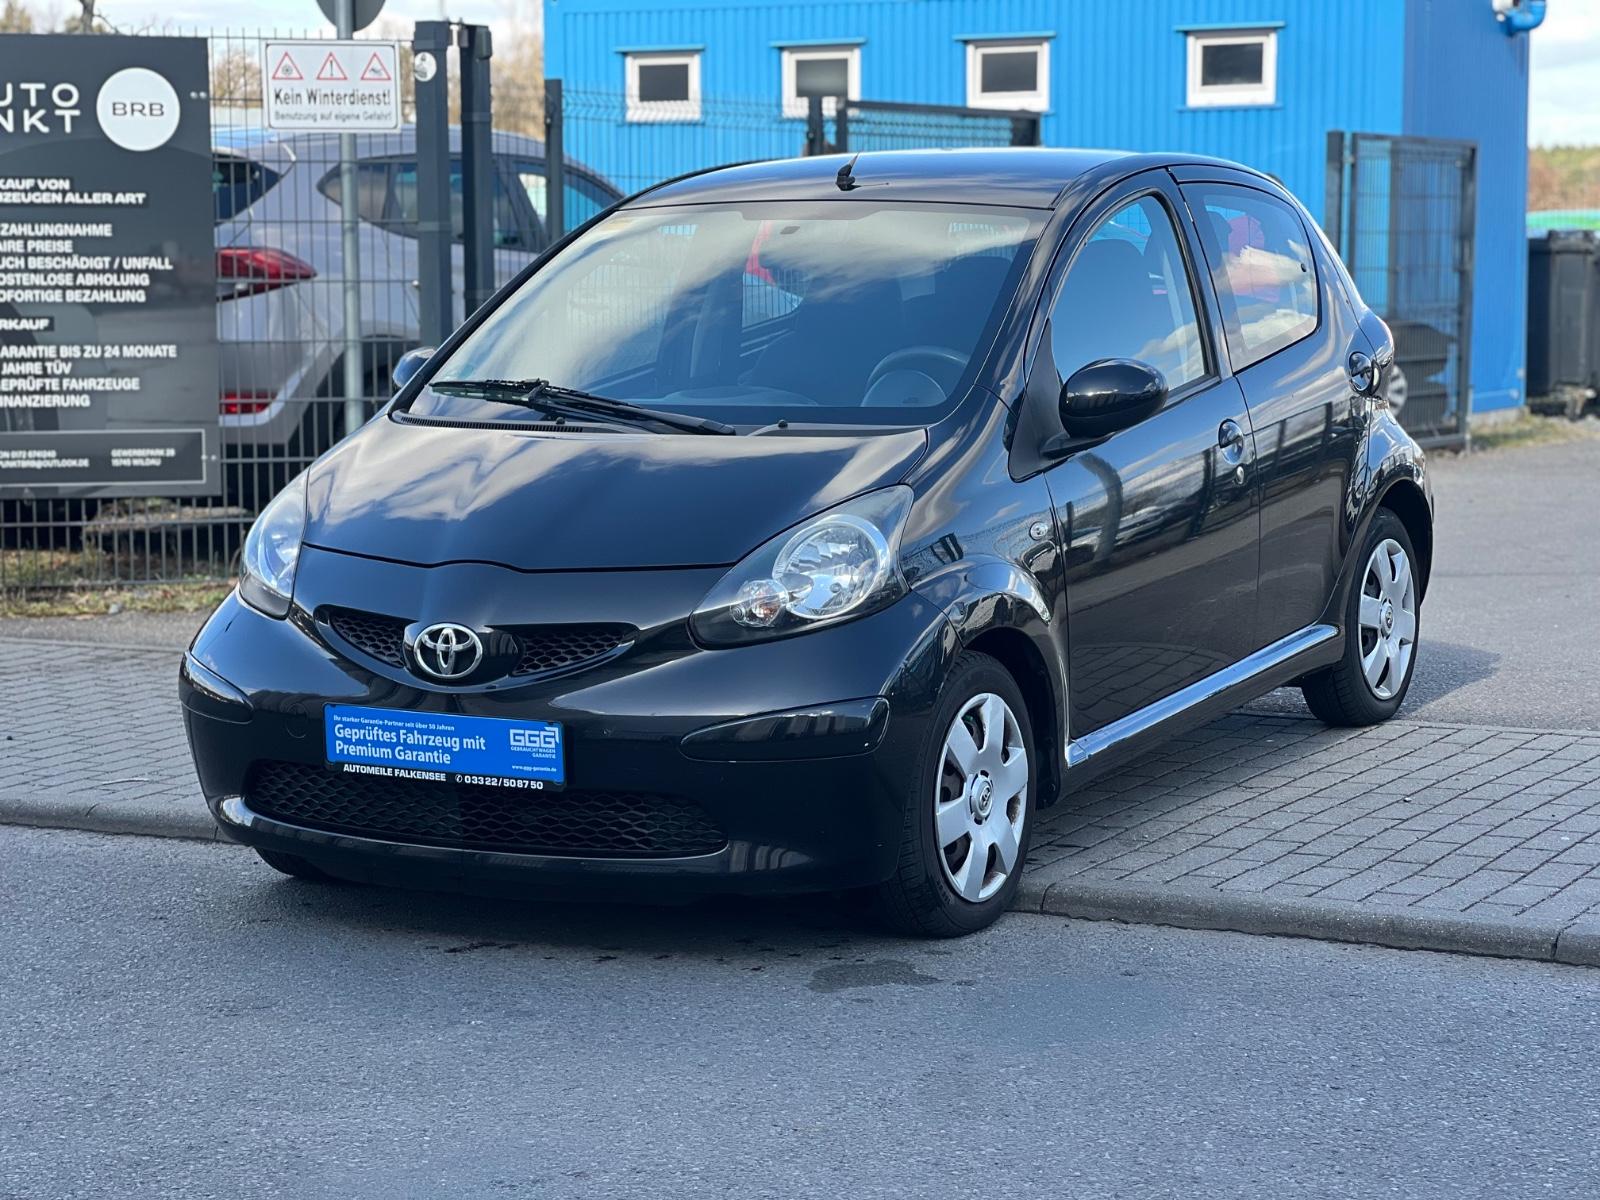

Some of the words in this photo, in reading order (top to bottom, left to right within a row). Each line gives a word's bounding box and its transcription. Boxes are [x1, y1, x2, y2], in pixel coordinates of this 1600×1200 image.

[274, 88, 302, 105] Kein
[306, 88, 391, 105] Winterdienst!
[112, 102, 165, 117] BRB
[275, 112, 317, 122] Benutzung
[320, 111, 332, 120] auf
[334, 112, 360, 122] eigene
[37, 178, 70, 190] VON
[64, 192, 113, 204] ALLER
[114, 193, 146, 204] ART
[27, 239, 73, 253] PREISE
[27, 254, 111, 270] BESCHÄDIGT
[122, 256, 173, 270] UNFALL
[76, 273, 150, 287] ABHOLUNG
[65, 289, 146, 303] BEZAHLUNG
[60, 345, 81, 358] BIS
[83, 345, 102, 358] ZU
[103, 345, 121, 358] 24
[123, 345, 177, 358] MONATE
[1, 361, 43, 375] JAHRE
[45, 359, 72, 375] TÜV
[62, 377, 140, 391] FAHRZEUGE
[361, 717, 404, 727] Garantie-Partner
[415, 721, 428, 729] über
[334, 724, 397, 742] Geprüftes
[400, 729, 460, 751] Fahrzeug
[463, 736, 486, 750] mit
[509, 727, 559, 749] GGG
[336, 740, 392, 759] Premium
[395, 746, 451, 764] Garantie
[343, 764, 393, 777] AUTOMEILE
[394, 769, 447, 781] FALKENSEE
